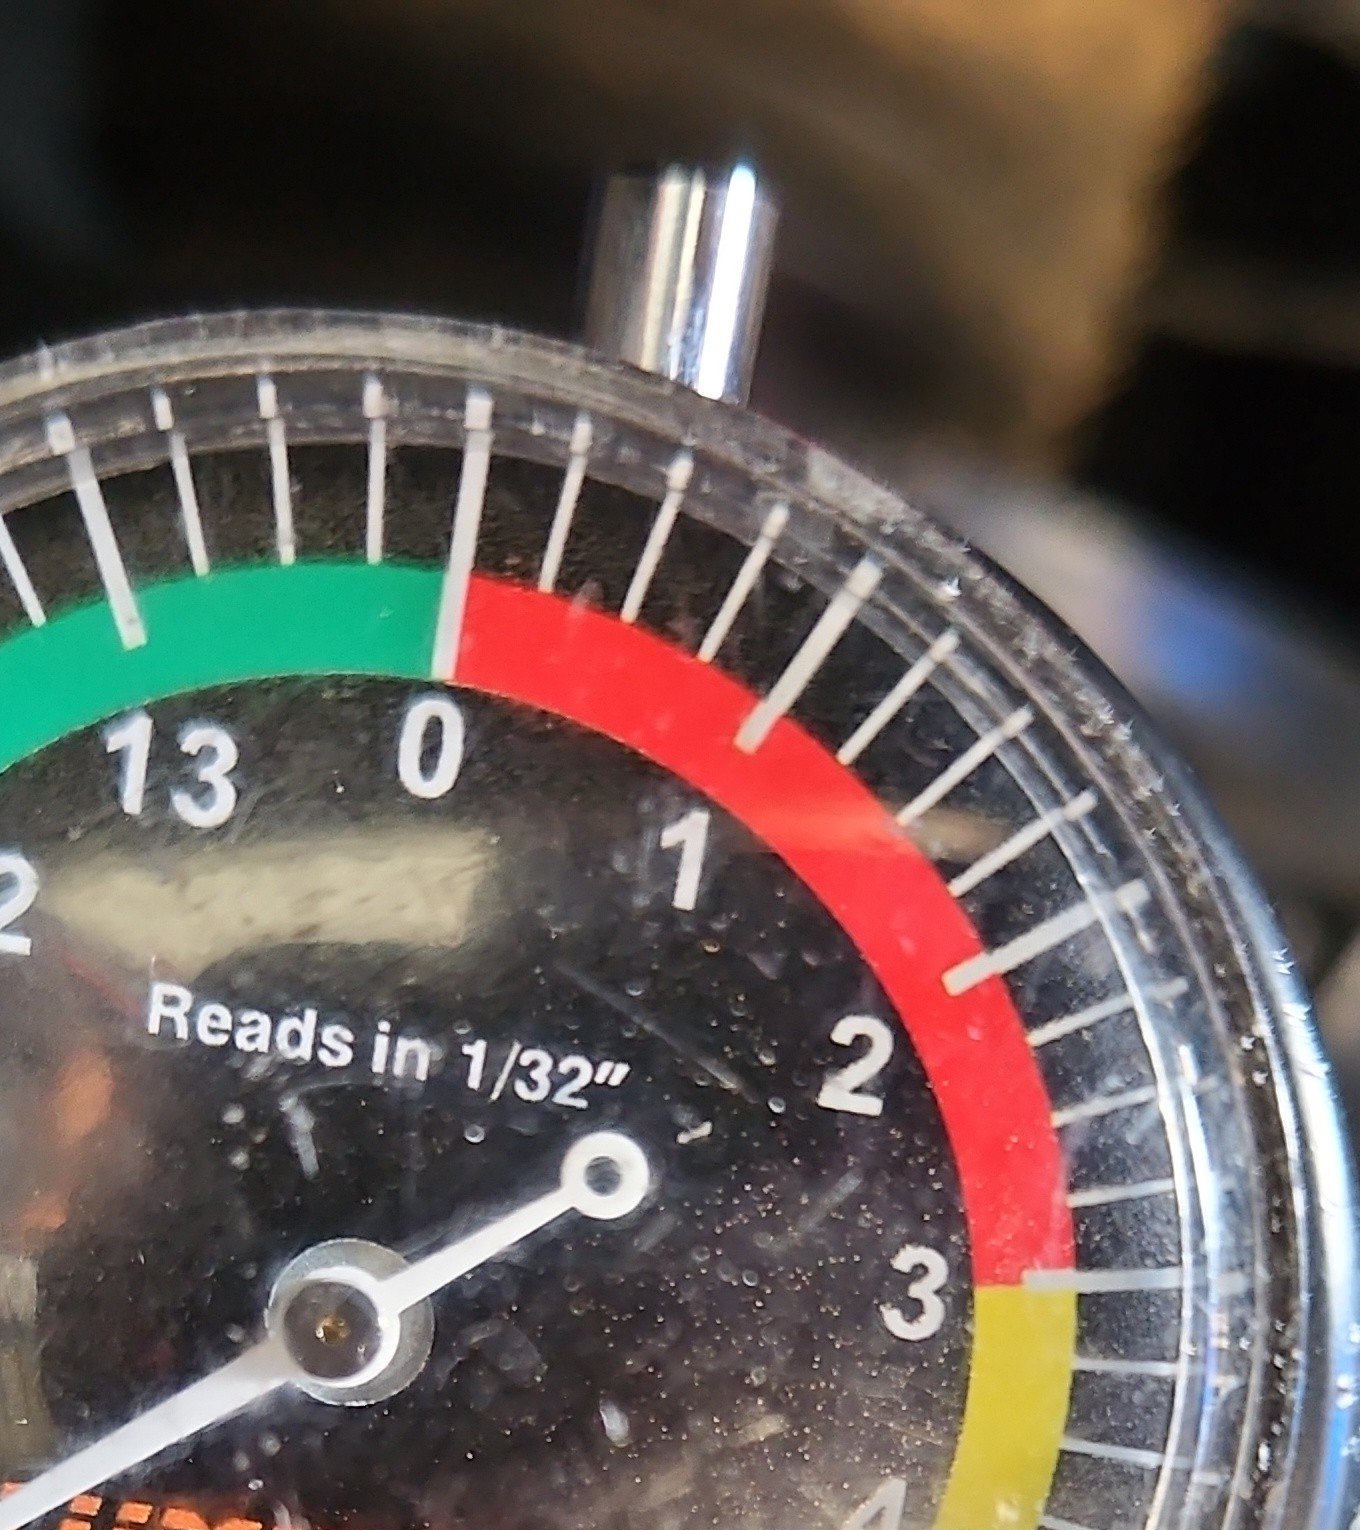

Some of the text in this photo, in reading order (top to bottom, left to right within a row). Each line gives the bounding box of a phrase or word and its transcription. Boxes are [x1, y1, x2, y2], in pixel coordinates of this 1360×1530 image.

[106, 712, 239, 828] 13
[396, 698, 465, 799] 0
[660, 809, 711, 912] 1
[146, 980, 354, 1068] Reads
[371, 1020, 431, 1082] in
[816, 1014, 895, 1117] 2
[879, 1244, 950, 1342] 3
